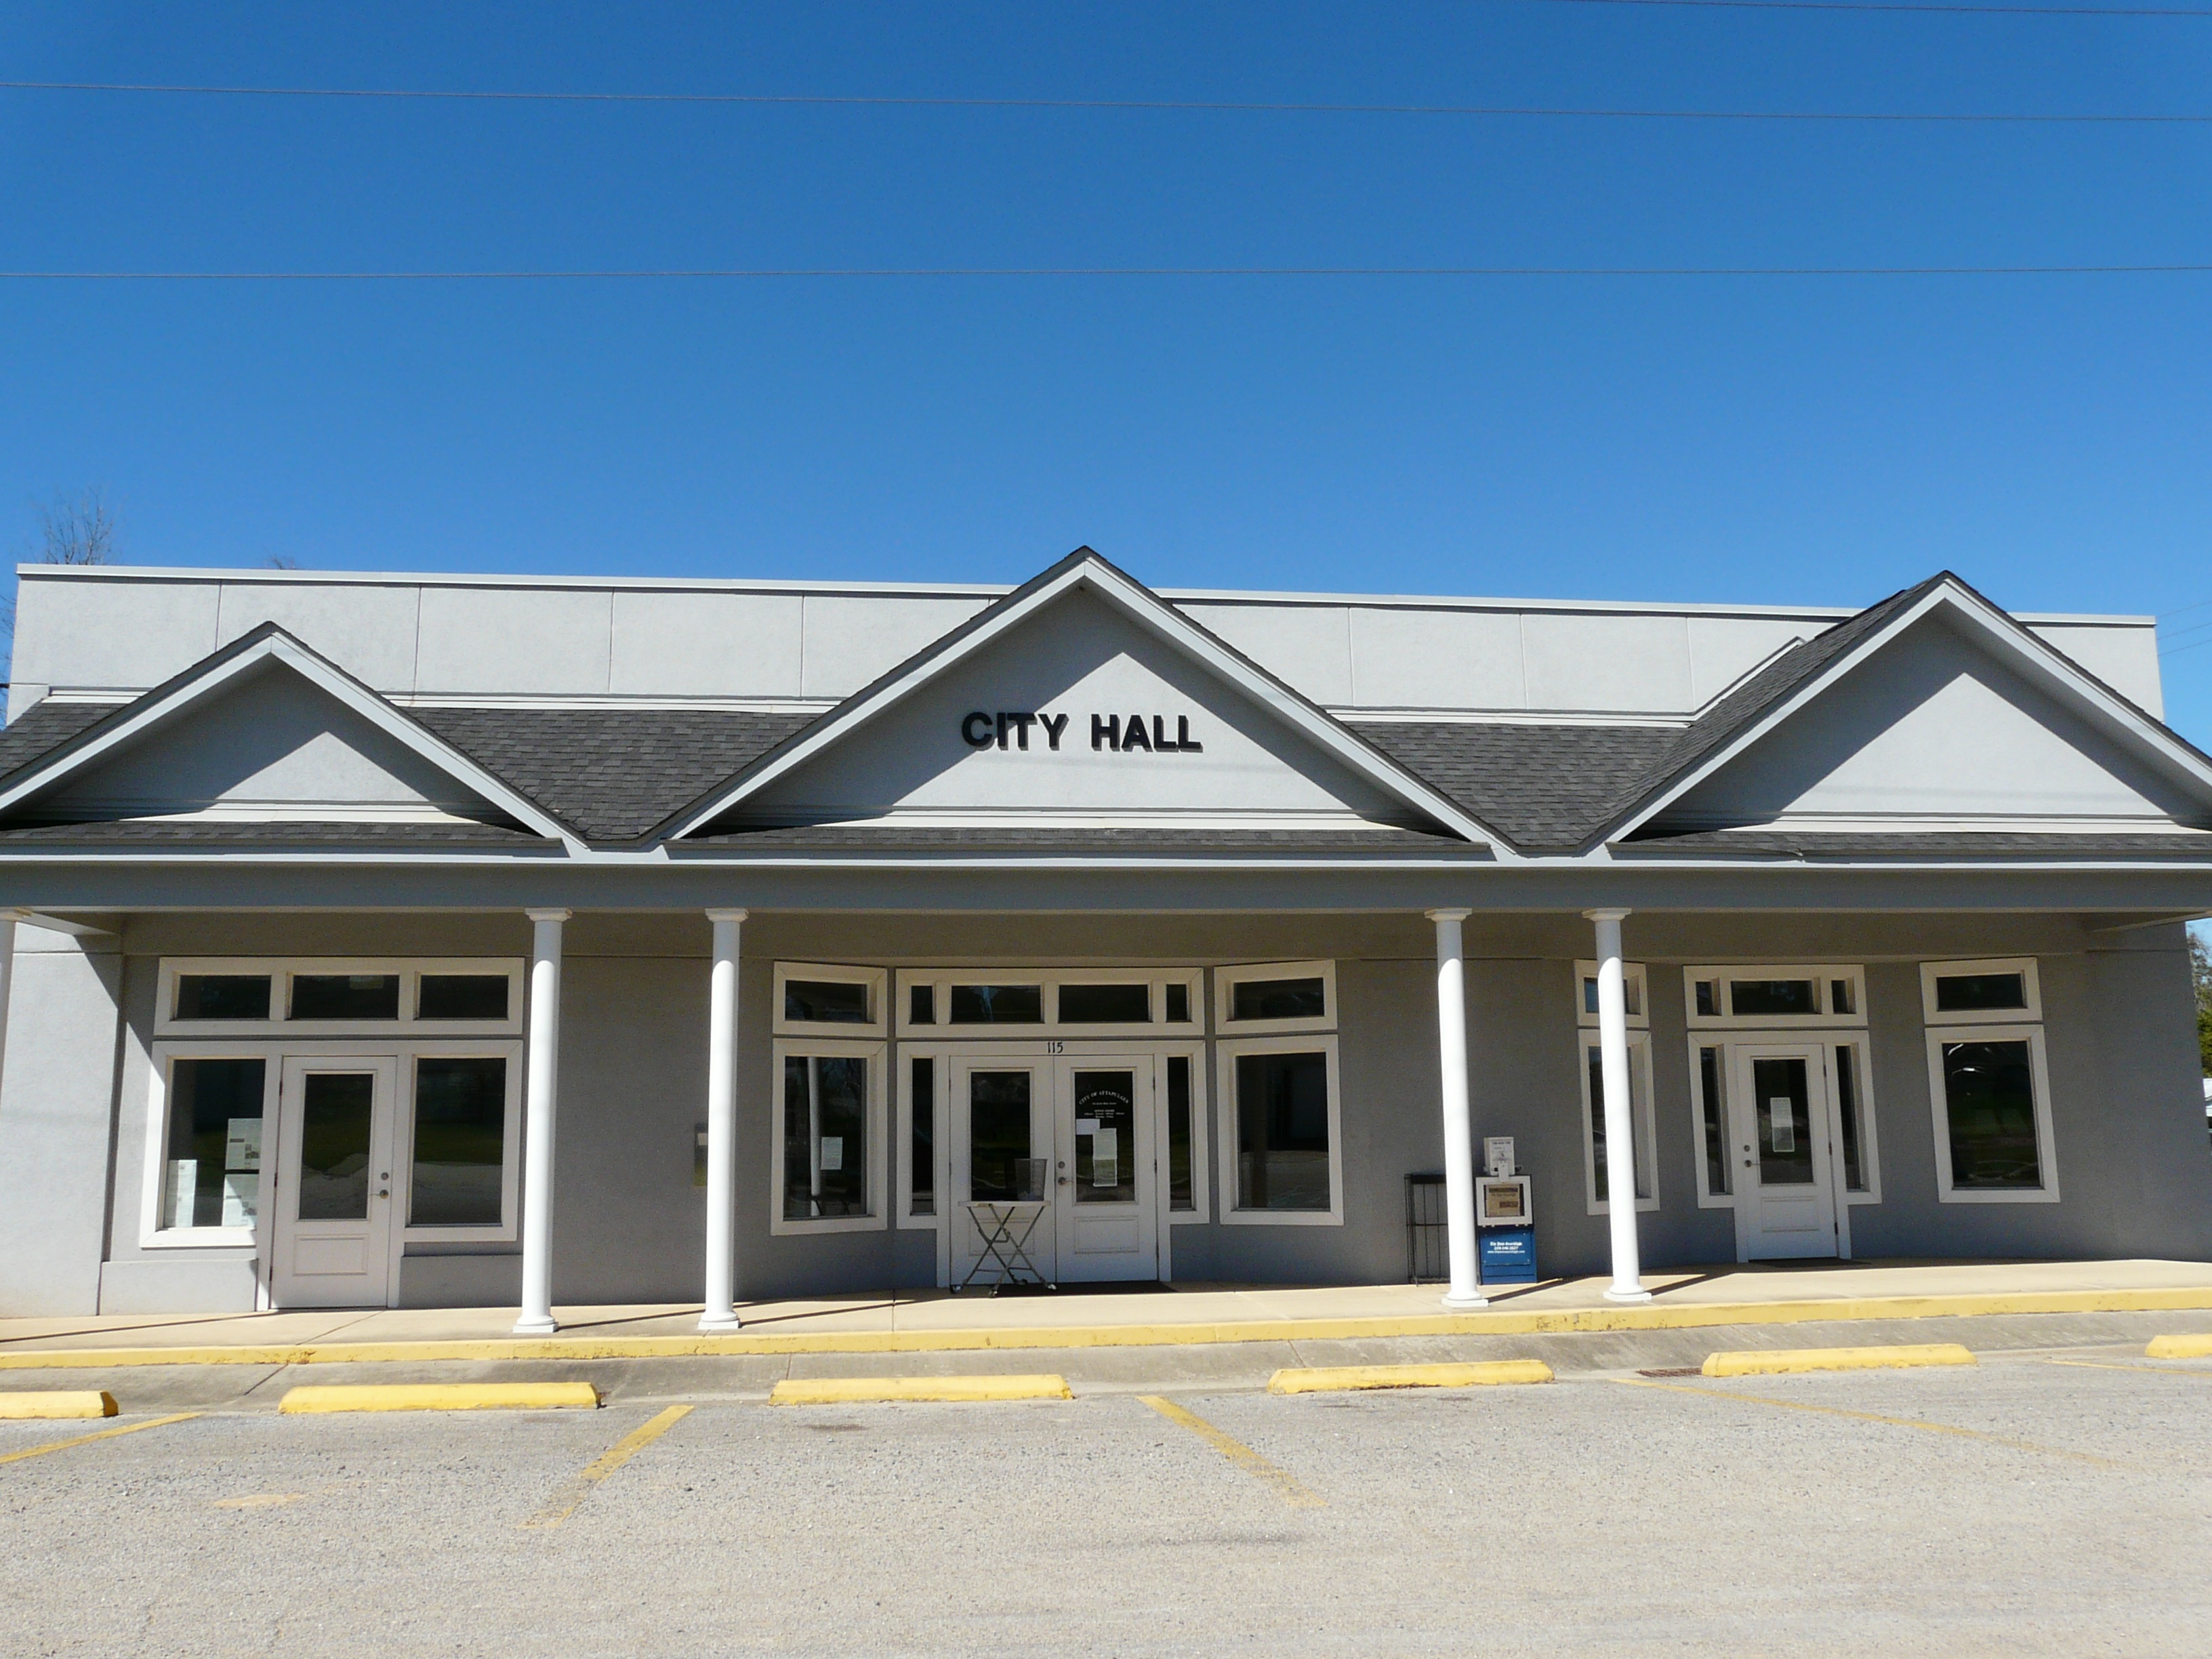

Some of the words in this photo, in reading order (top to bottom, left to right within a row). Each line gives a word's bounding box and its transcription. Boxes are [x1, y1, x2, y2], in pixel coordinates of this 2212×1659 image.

[962, 712, 1069, 752] CITY
[1091, 714, 1203, 752] HALL
[1048, 1042, 1063, 1054] 115
[1079, 1094, 1090, 1105] CITY
